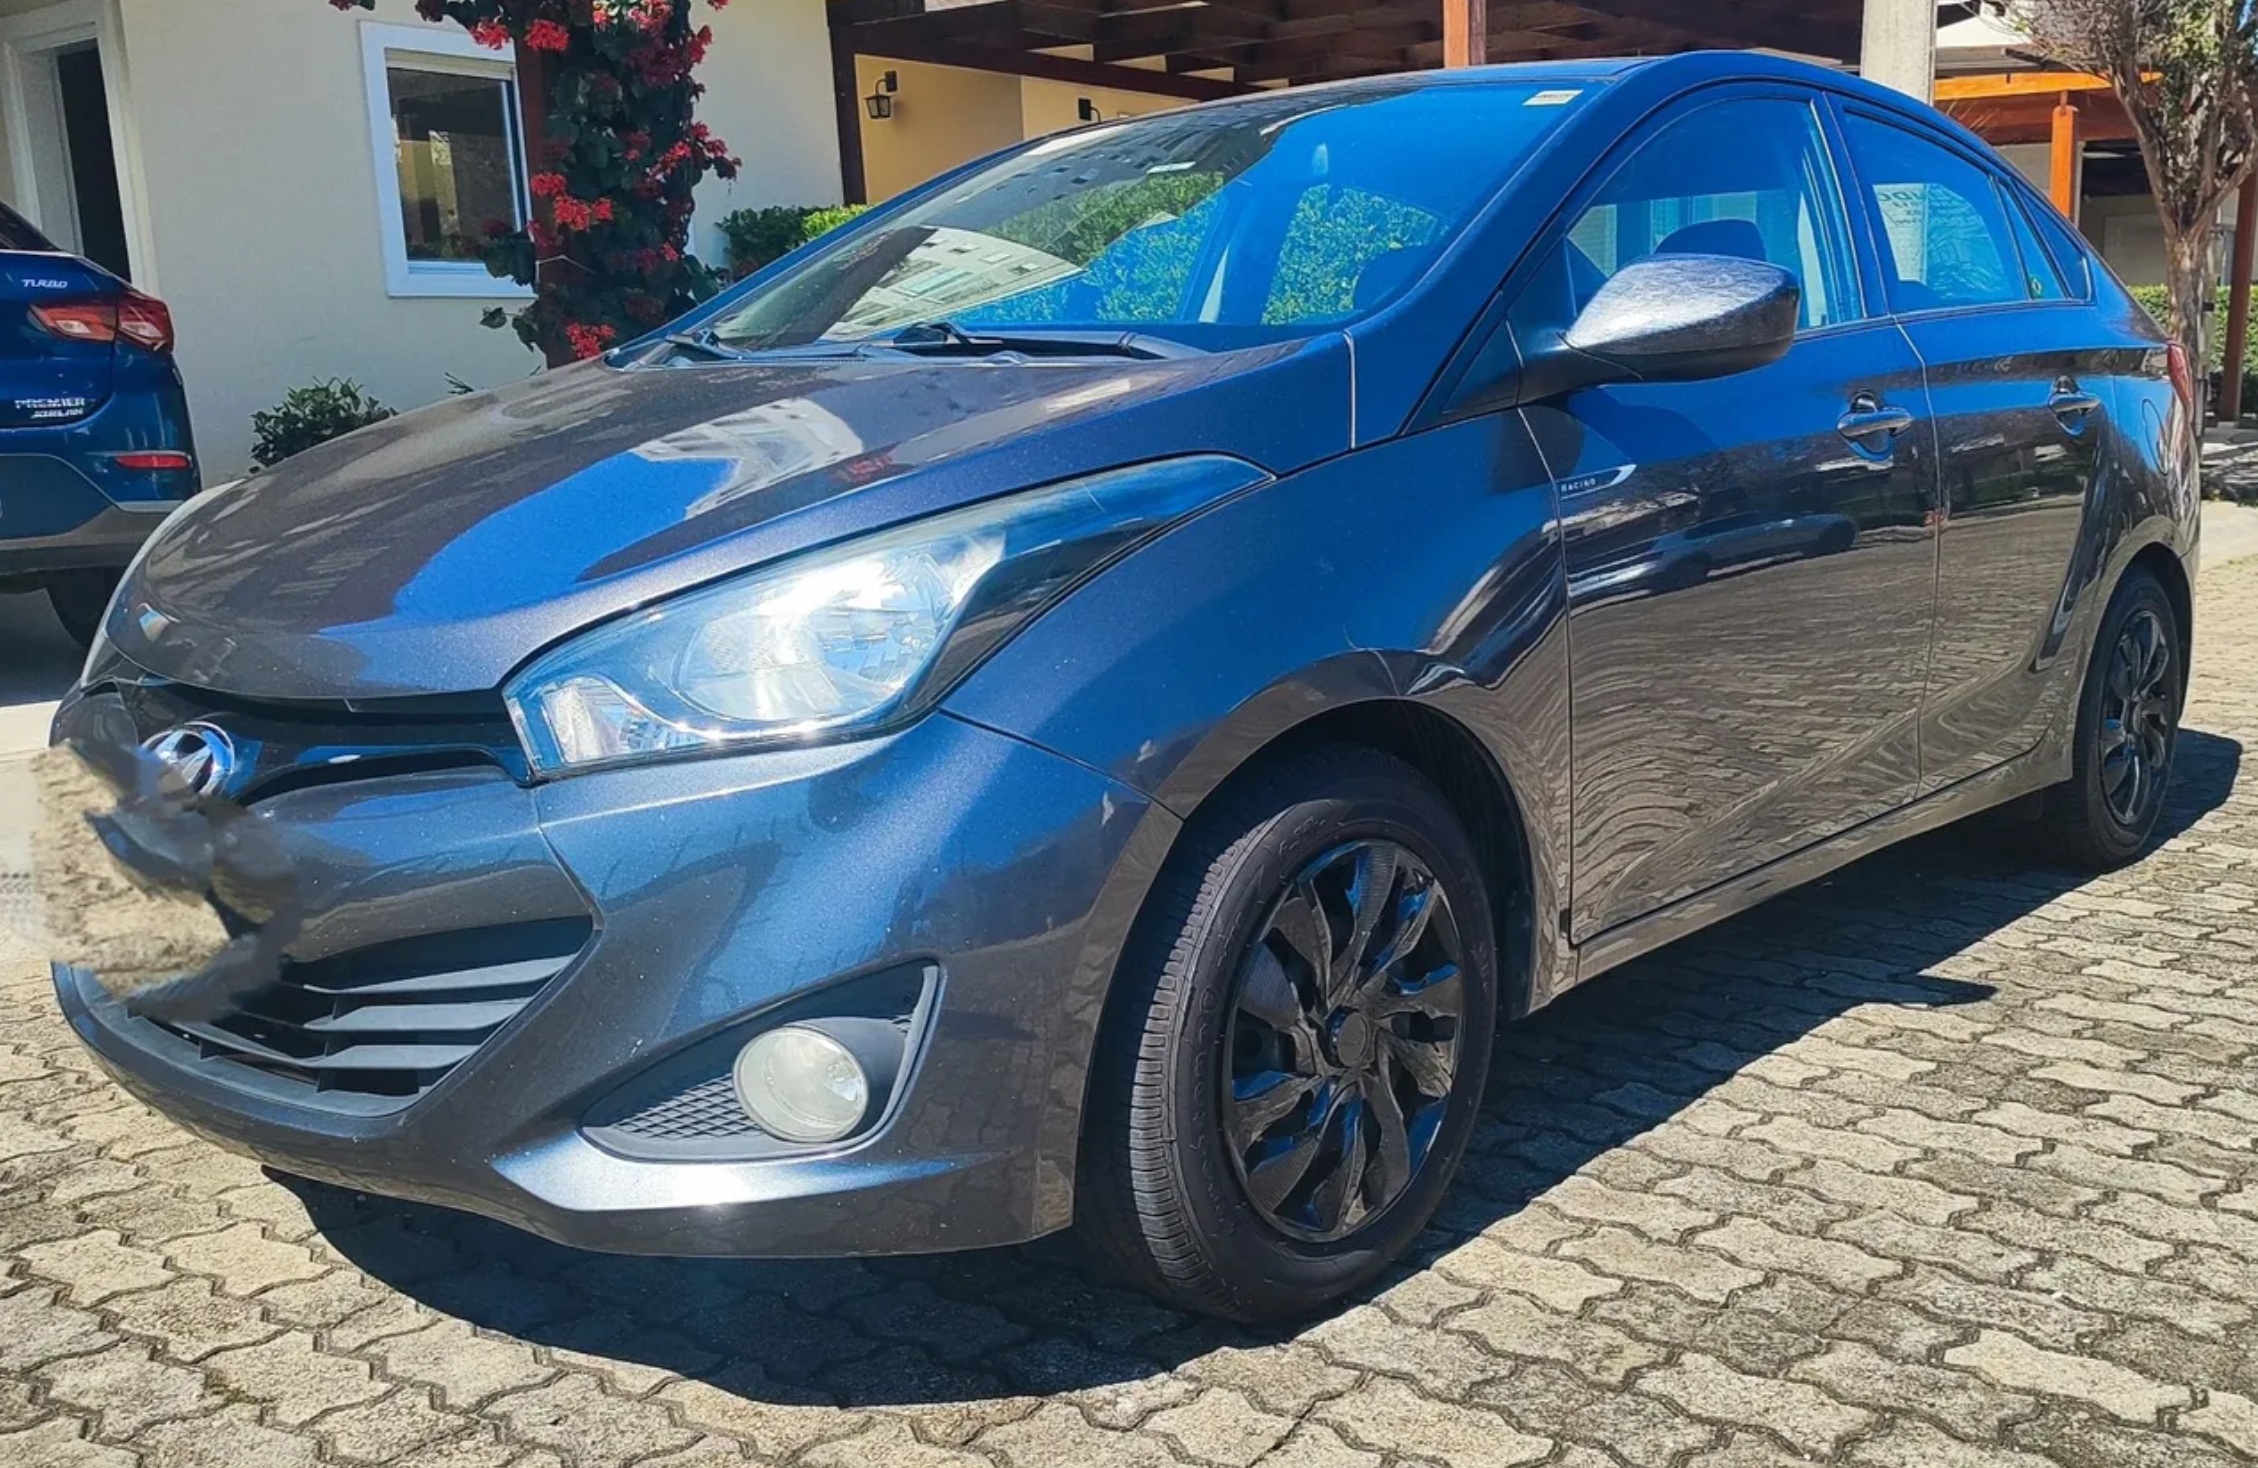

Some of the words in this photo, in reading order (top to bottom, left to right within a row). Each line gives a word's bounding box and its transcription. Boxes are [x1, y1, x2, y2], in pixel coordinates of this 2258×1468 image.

[21, 279, 68, 289] TURBO
[15, 397, 86, 409] PREMIER
[1560, 478, 1596, 493] RACING
